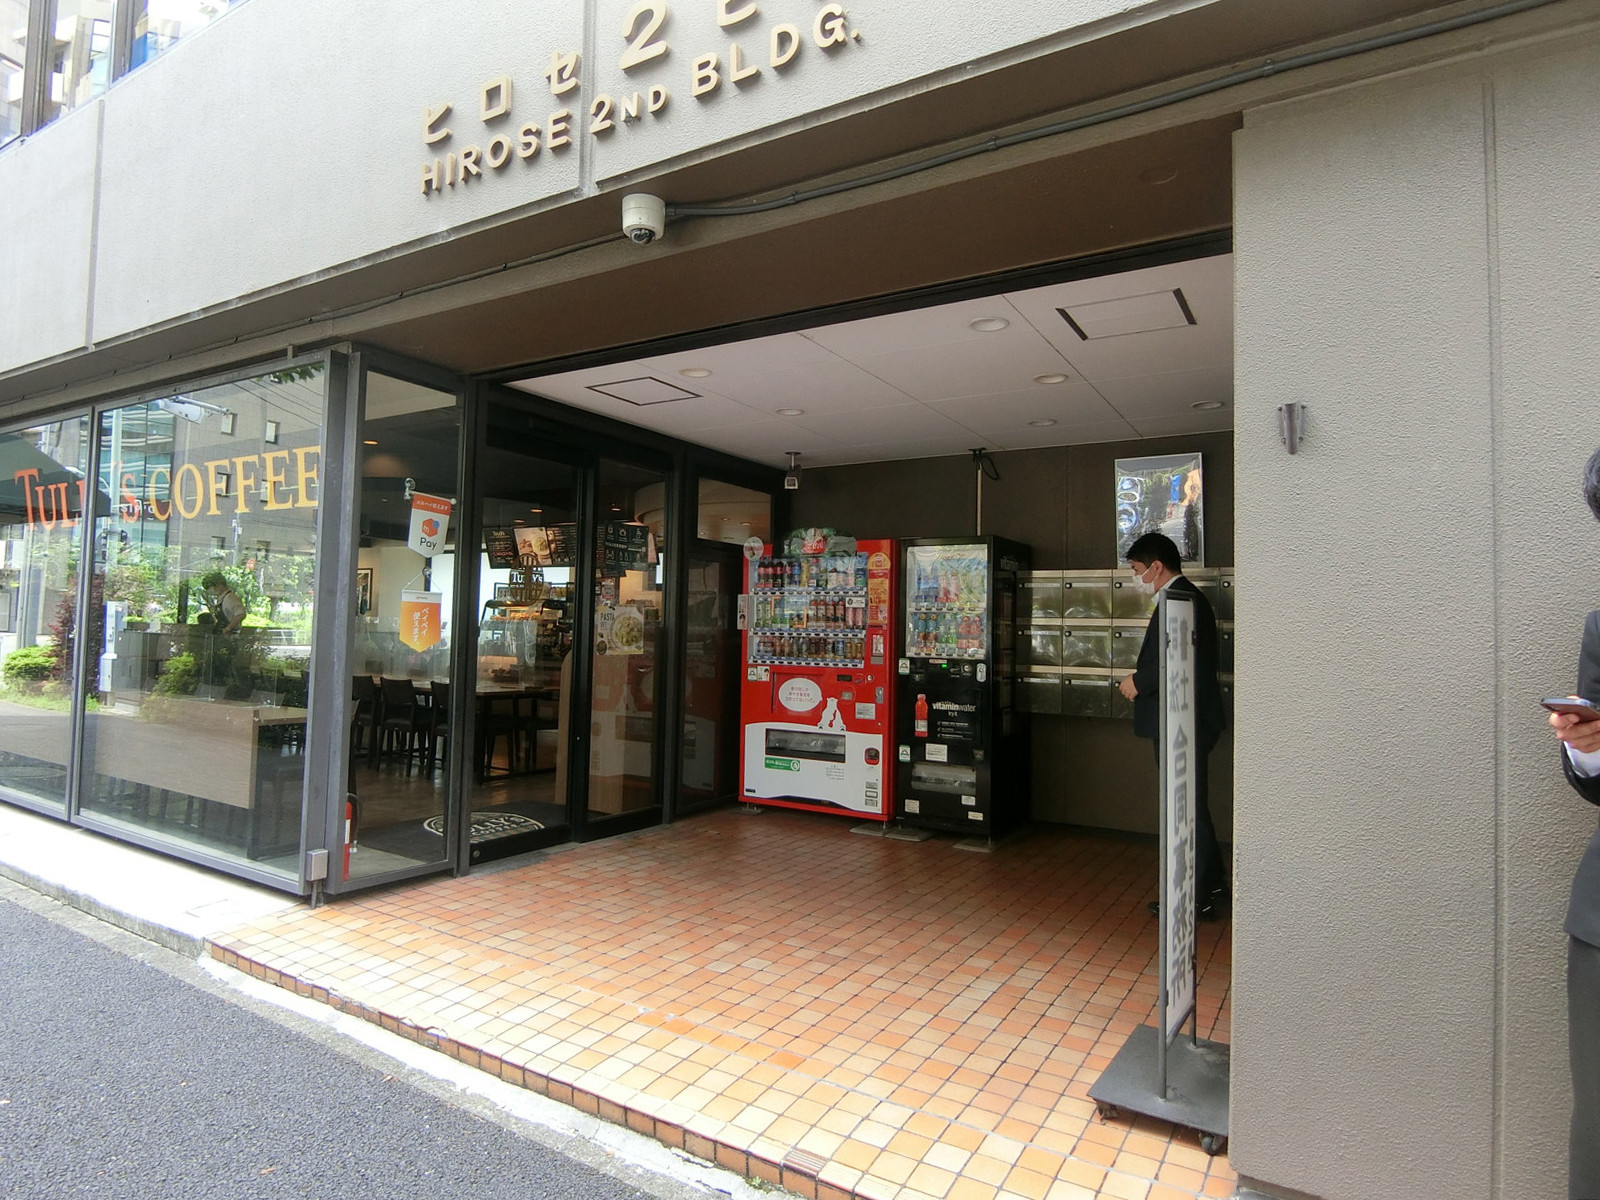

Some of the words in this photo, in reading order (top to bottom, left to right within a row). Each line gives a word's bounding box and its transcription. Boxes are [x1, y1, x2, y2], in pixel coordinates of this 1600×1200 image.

[420, 108, 573, 195] HIROSE
[589, 84, 669, 135] 2ND
[691, 3, 861, 99] BLDG.
[149, 445, 321, 522] COFFEE
[419, 536, 438, 551] Pay
[511, 571, 543, 584] TUY'S
[421, 606, 430, 637] ペイペイ
[600, 612, 615, 622] PASTA
[932, 702, 976, 712] vitaminwater
[471, 816, 526, 833] LLY'S
